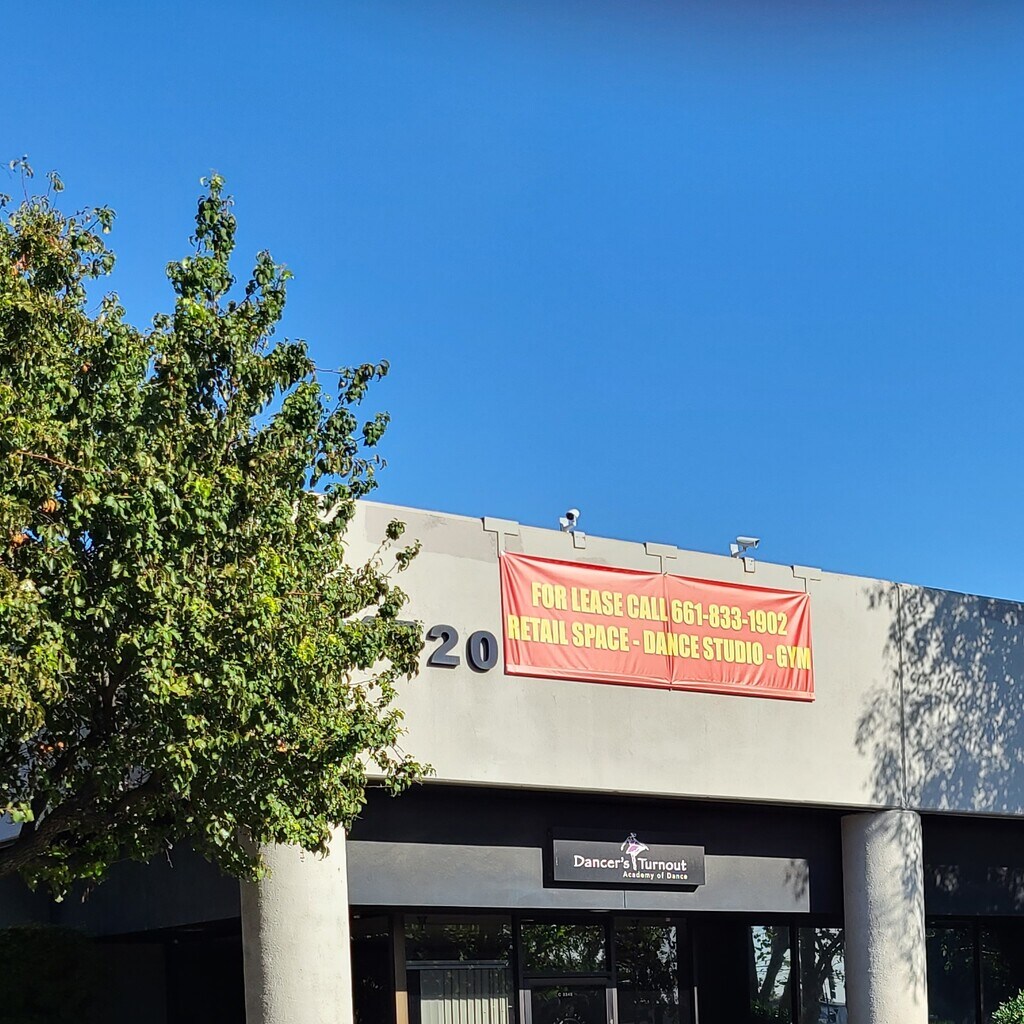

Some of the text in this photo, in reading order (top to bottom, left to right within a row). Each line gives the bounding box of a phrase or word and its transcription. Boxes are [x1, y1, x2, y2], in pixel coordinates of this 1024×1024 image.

[531, 581, 788, 636] FOR LEASE CALL 661-833-1902
[393, 619, 498, 674] 20
[507, 614, 569, 646] RETAIL
[571, 621, 630, 652] SPACE
[643, 629, 700, 659] DANCE
[702, 636, 763, 666] STUDIO
[776, 644, 811, 670] GYM
[573, 854, 687, 872] Dancer's Turnout
[623, 871, 688, 880] Academy of Dance
